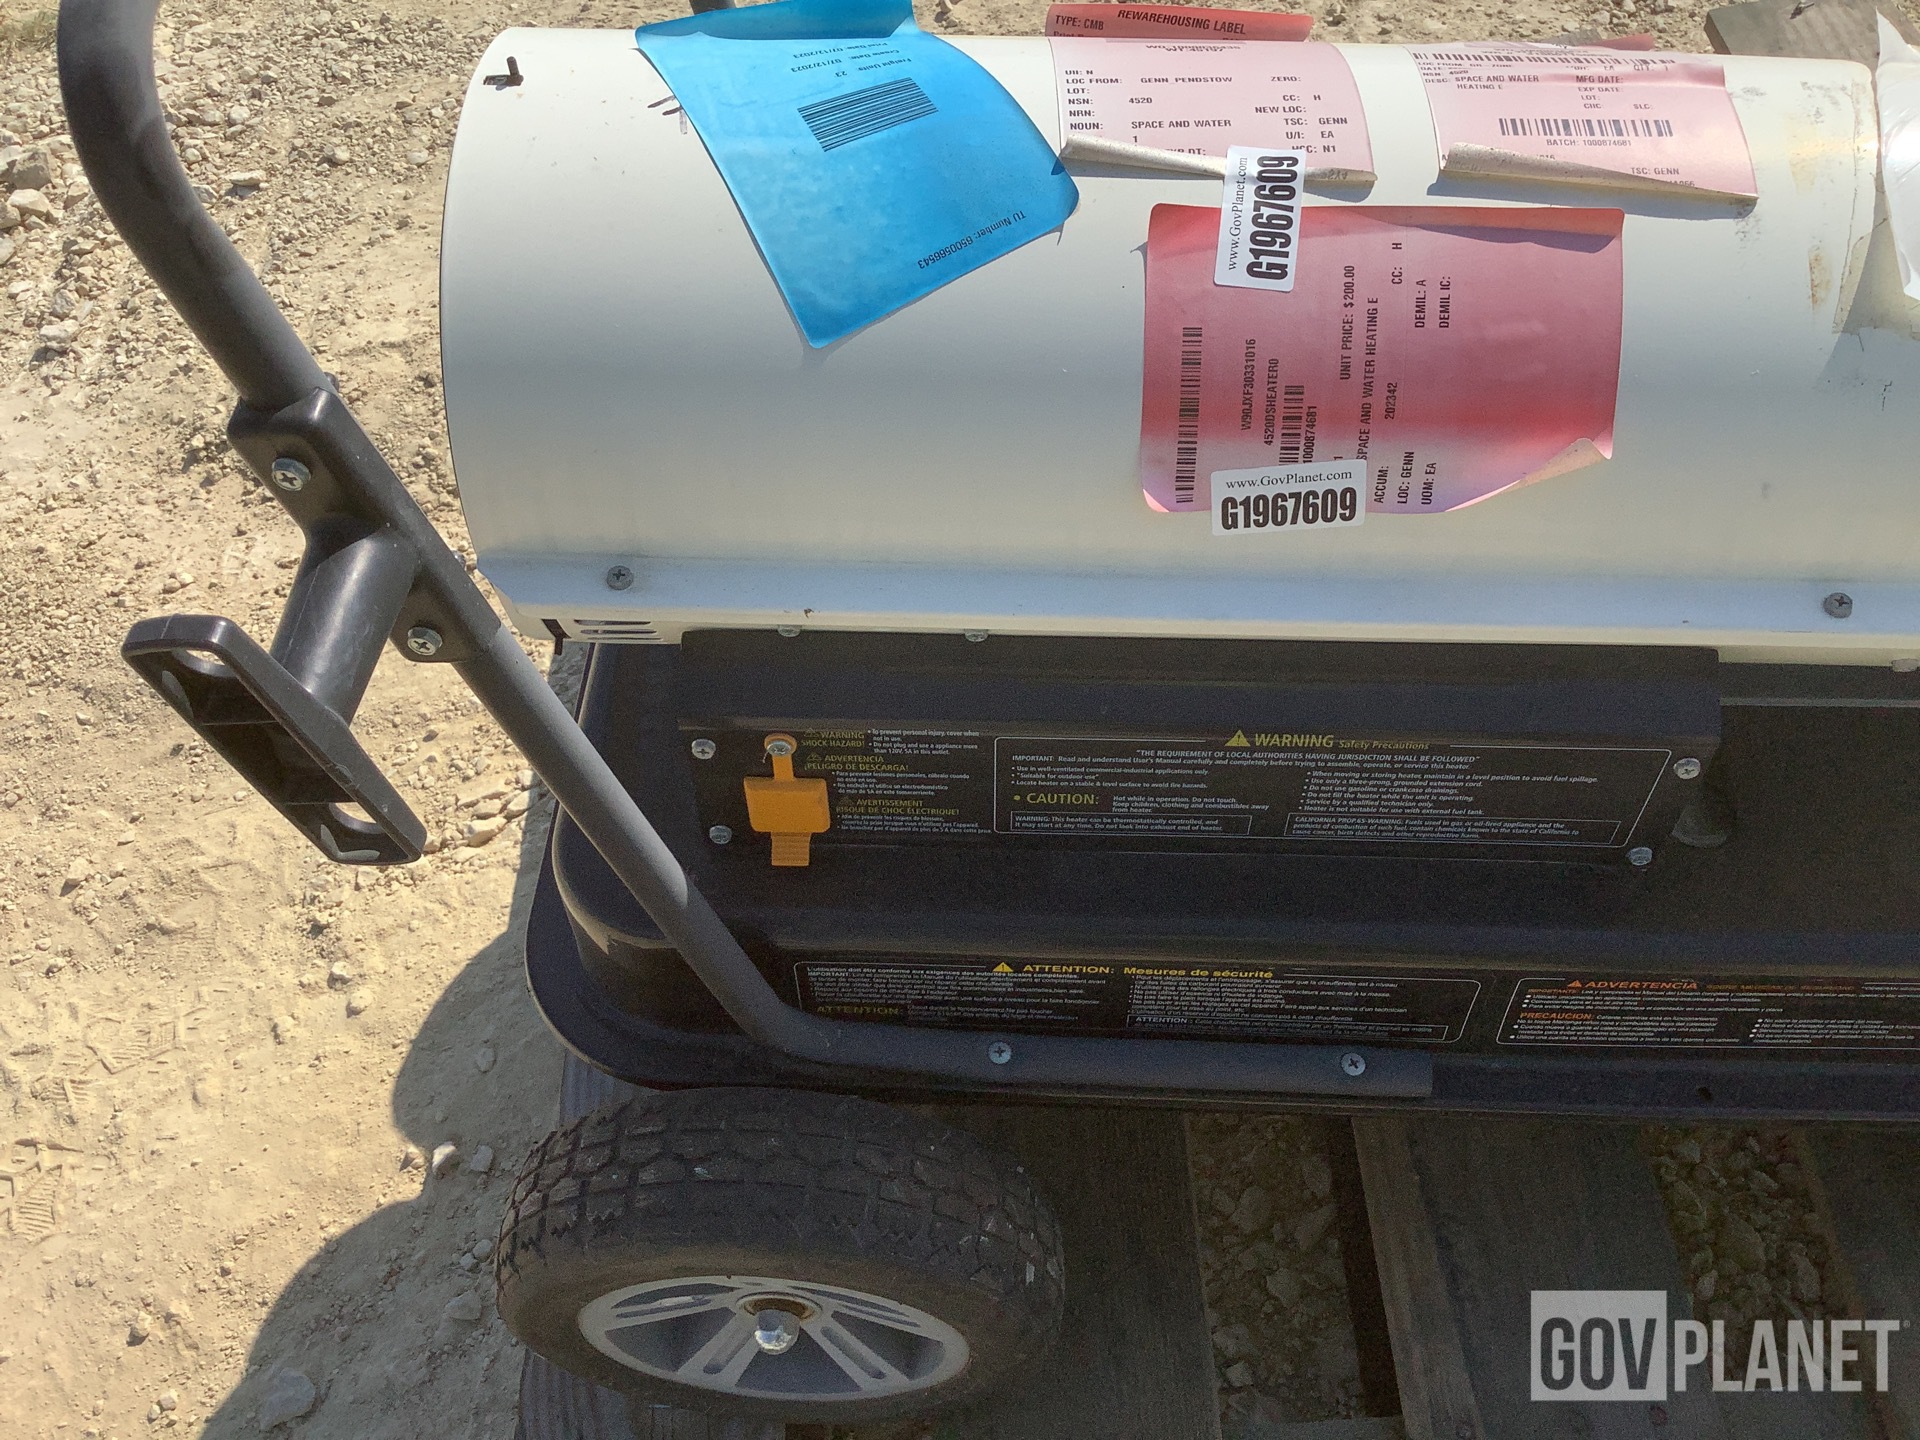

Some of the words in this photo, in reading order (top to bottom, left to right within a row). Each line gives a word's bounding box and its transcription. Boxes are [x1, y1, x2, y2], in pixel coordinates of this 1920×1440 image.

[1055, 14, 1081, 27] TYPE:
[1083, 18, 1104, 30] CMB
[1117, 9, 1210, 30] REWAREHOUSING
[1213, 19, 1246, 34] LABEL
[1455, 75, 1483, 83] SPACE
[1575, 75, 1595, 83] MFG
[1597, 75, 1624, 84] DATE:
[1282, 94, 1300, 102] CC:
[1255, 106, 1279, 114] NEW
[1070, 122, 1104, 130] NOUN:
[1131, 120, 1165, 129] SPACE
[1168, 120, 1191, 128] AND
[1194, 119, 1232, 128] WATER
[1283, 118, 1308, 126] TSC:
[1318, 117, 1348, 125] GENN
[1286, 131, 1305, 140] U/I:
[1320, 131, 1335, 139] EA
[1323, 145, 1336, 153] N1
[1630, 167, 1651, 175] TSC:
[1654, 167, 1679, 175] GENN
[1012, 210, 1027, 222] TU
[1228, 157, 1248, 270] www.GovPlanet.com
[1246, 156, 1299, 280] G1967609
[973, 217, 1012, 239] Number:
[917, 235, 974, 269] 6500566543
[1392, 242, 1402, 250] H
[1391, 266, 1403, 285] CC:
[1416, 279, 1427, 287] A
[1439, 276, 1451, 291] IC:
[1343, 265, 1355, 308] $200.00
[1415, 290, 1426, 328] DEMIL:
[1438, 294, 1451, 329] DEMIL
[1341, 313, 1354, 350] PRICE:
[1365, 308, 1378, 356] HEATING
[1340, 354, 1351, 380] UNIT
[1362, 359, 1375, 399] WATER
[1384, 382, 1398, 420] 202342
[1360, 402, 1372, 425] AND
[1302, 405, 1318, 464] 1000874681
[1356, 428, 1370, 460] SPACE
[1401, 451, 1415, 478] GENN
[1425, 462, 1437, 475] EA
[1226, 471, 1352, 489] www.GovPlanet.com
[1373, 465, 1389, 504] ACCUM:
[1397, 481, 1410, 504] LOC:
[1421, 478, 1434, 505] UOM:
[1221, 486, 1357, 531] G1967609
[802, 739, 828, 747] SHOCK
[820, 731, 865, 739] WARNING
[1255, 733, 1334, 748] WARNING
[1340, 740, 1370, 750] Safety
[1372, 741, 1430, 750] Precautions
[824, 754, 884, 763] ADVERTENCIA
[1157, 749, 1212, 757] REQUIREMENT
[1214, 750, 1224, 758] OF
[1226, 751, 1251, 759] LOCAL
[1337, 753, 1391, 761] JURISDICTION
[859, 763, 909, 772] DESCARGA!
[856, 799, 923, 807] AVERTISSEMENT
[1026, 793, 1099, 805] CAUTION:
[836, 806, 866, 814] RISQUE
[881, 806, 905, 814] CHOC
[1023, 964, 1115, 974] ATTENTION:
[1123, 967, 1186, 976] Mesures
[1190, 969, 1210, 977] de
[1212, 969, 1274, 978] sécurité
[1584, 981, 1698, 989] ADVERTENCIA
